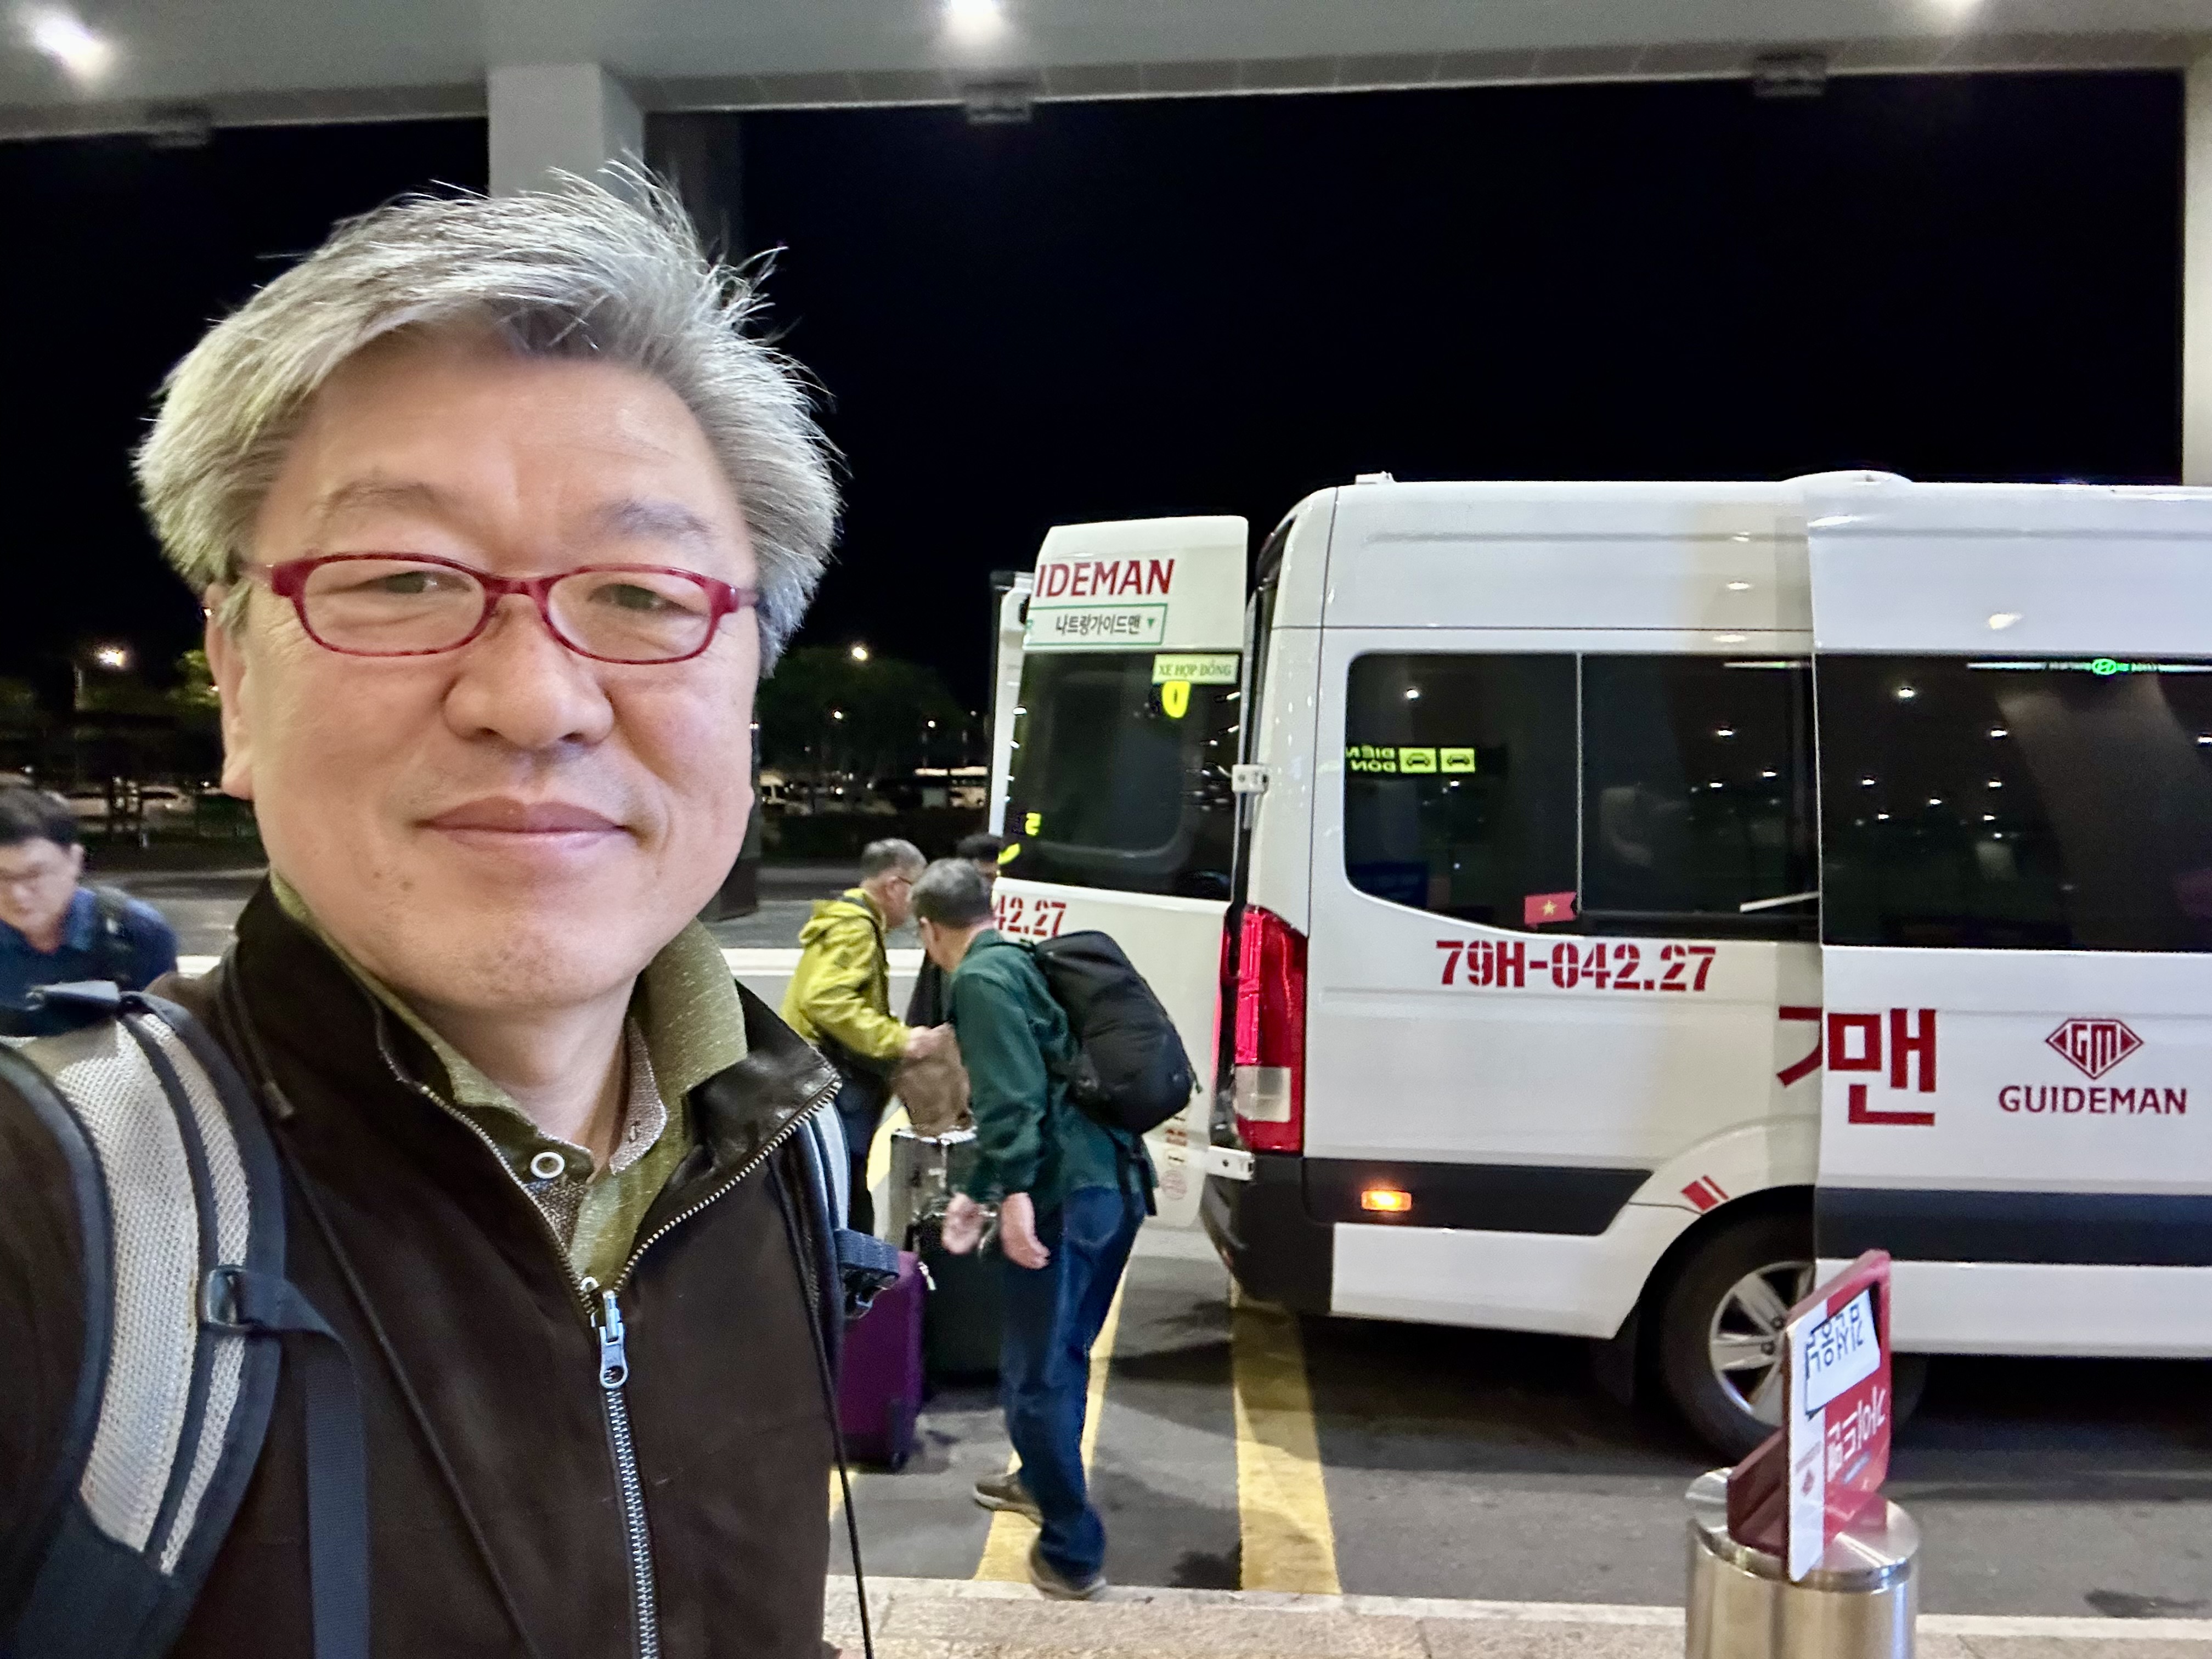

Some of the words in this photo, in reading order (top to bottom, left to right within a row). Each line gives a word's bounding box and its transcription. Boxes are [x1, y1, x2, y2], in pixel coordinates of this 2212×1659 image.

[1036, 558, 1175, 597] IDEMAN
[1056, 613, 1141, 636] 나트랑가이드맨
[1436, 940, 1716, 991] 79H-042.27
[1999, 1085, 2187, 1114] GUIDEMAN
